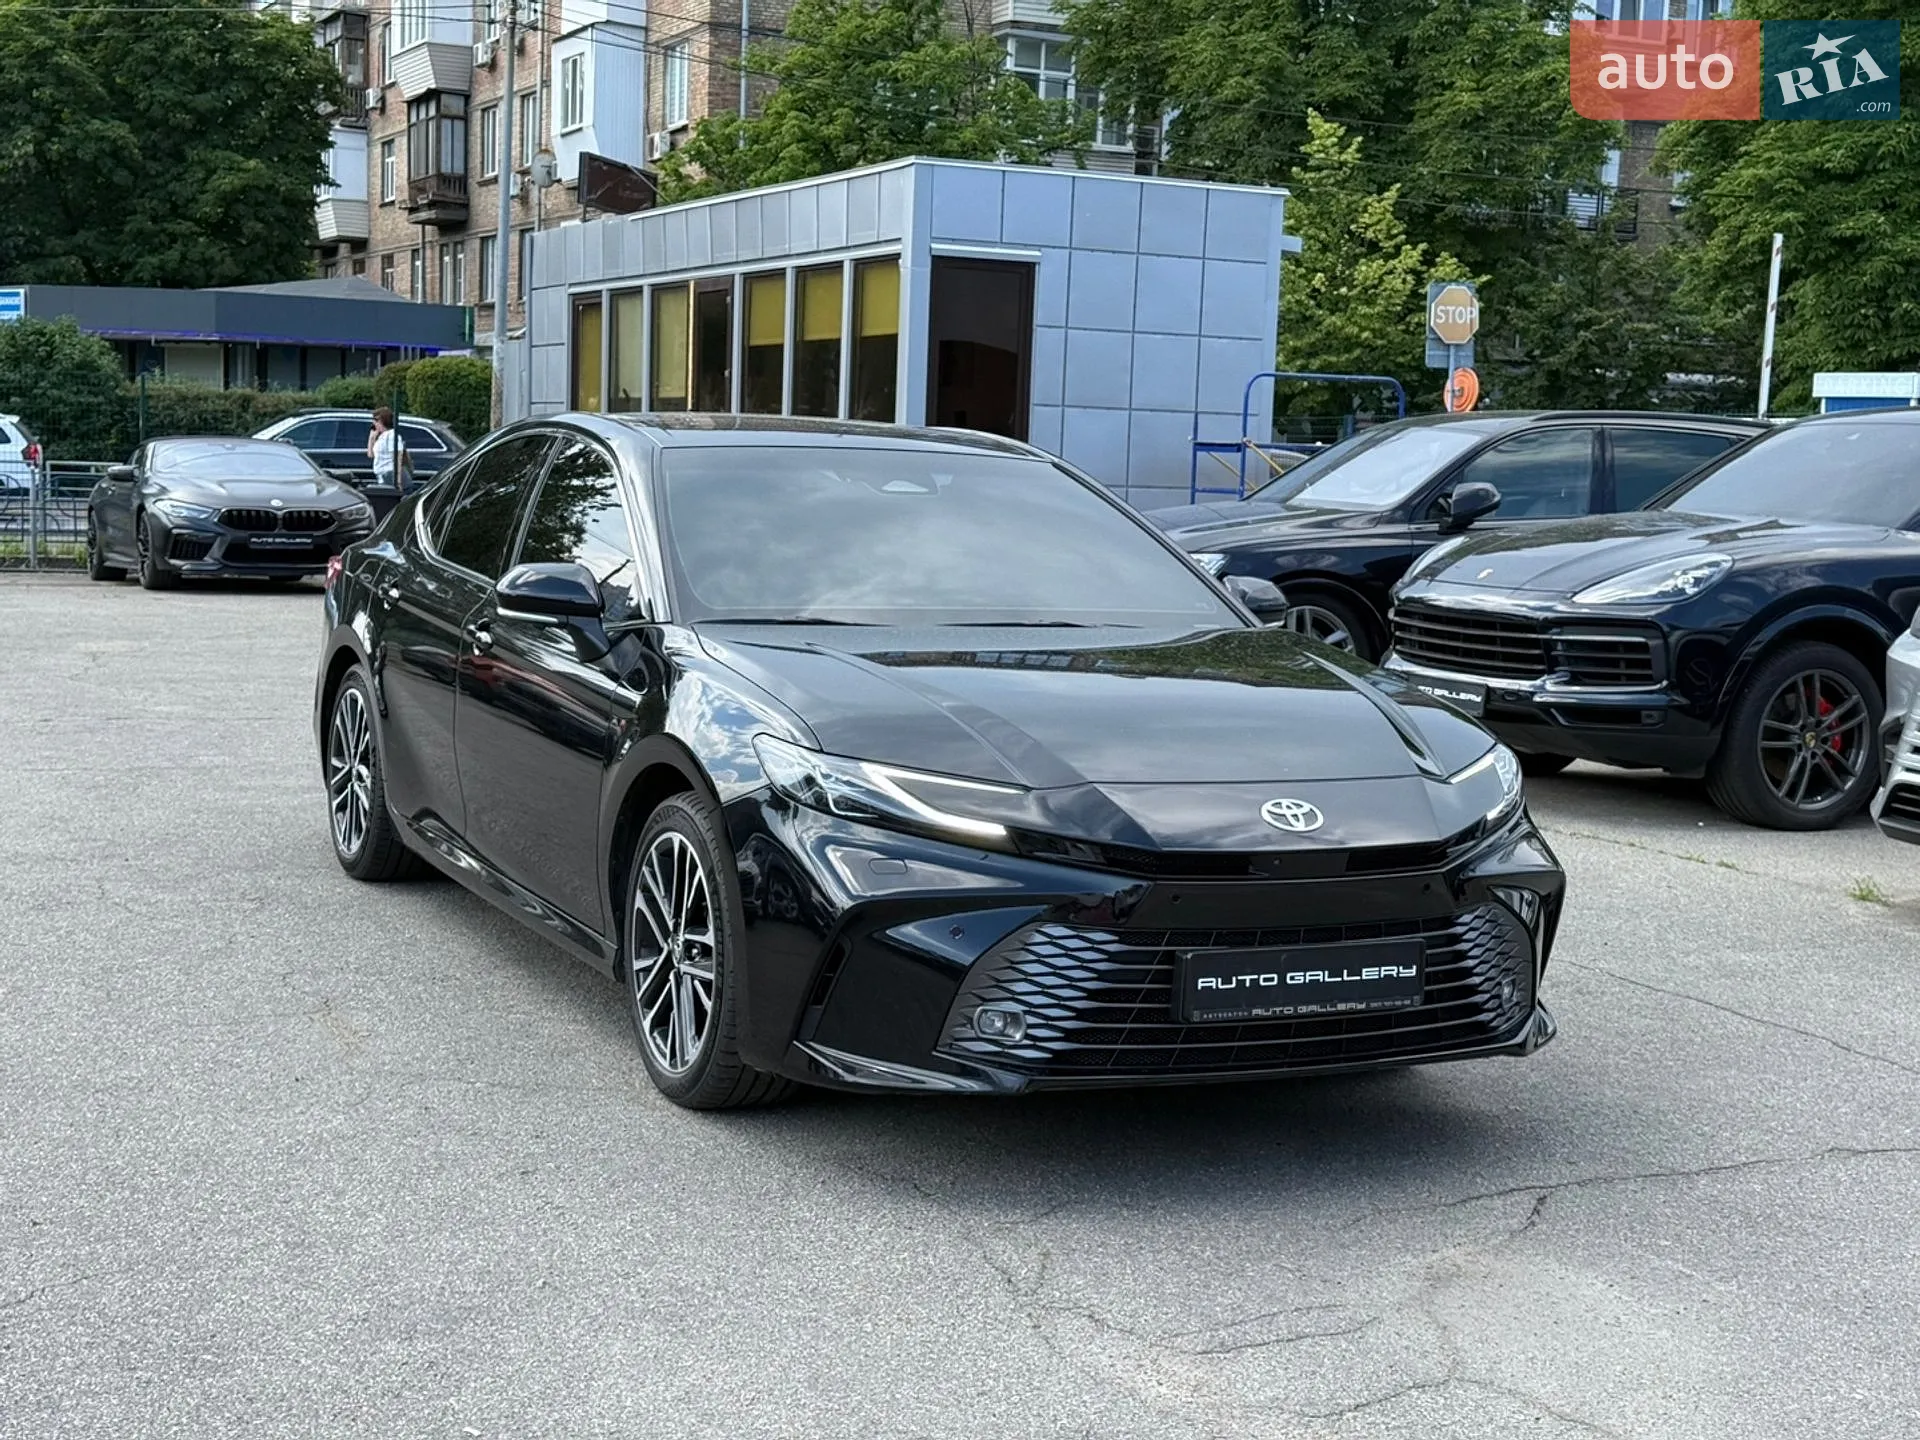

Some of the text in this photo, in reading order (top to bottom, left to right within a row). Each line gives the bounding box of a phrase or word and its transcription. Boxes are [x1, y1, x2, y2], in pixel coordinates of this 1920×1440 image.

[1437, 305, 1476, 324] STOP
[1197, 965, 1417, 991] AUTO GALLERY
[1251, 1007, 1294, 1017] AUTO
[1297, 1001, 1367, 1013] GALLERY
